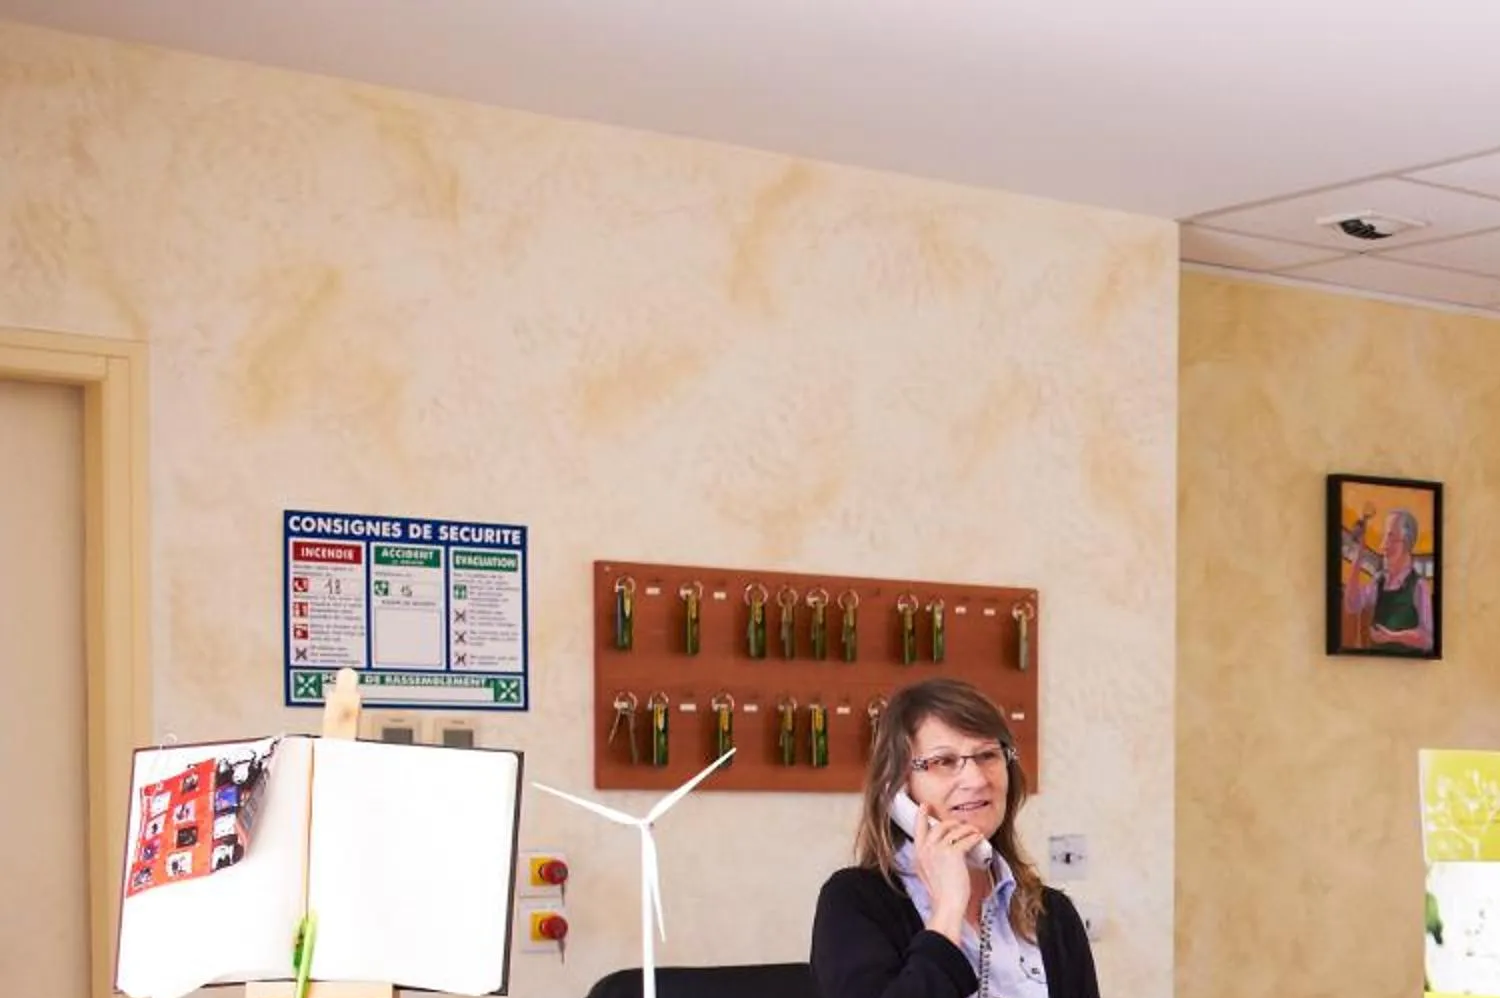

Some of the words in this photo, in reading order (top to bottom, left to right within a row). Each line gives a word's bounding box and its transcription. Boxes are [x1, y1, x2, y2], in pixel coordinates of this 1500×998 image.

[288, 516, 402, 538] CONSIGNES
[409, 523, 433, 540] DE
[439, 525, 521, 545] SECURITE
[301, 546, 354, 560] INCENDIE
[381, 547, 434, 561] ACCIDENT
[455, 555, 517, 570] EVACUATION
